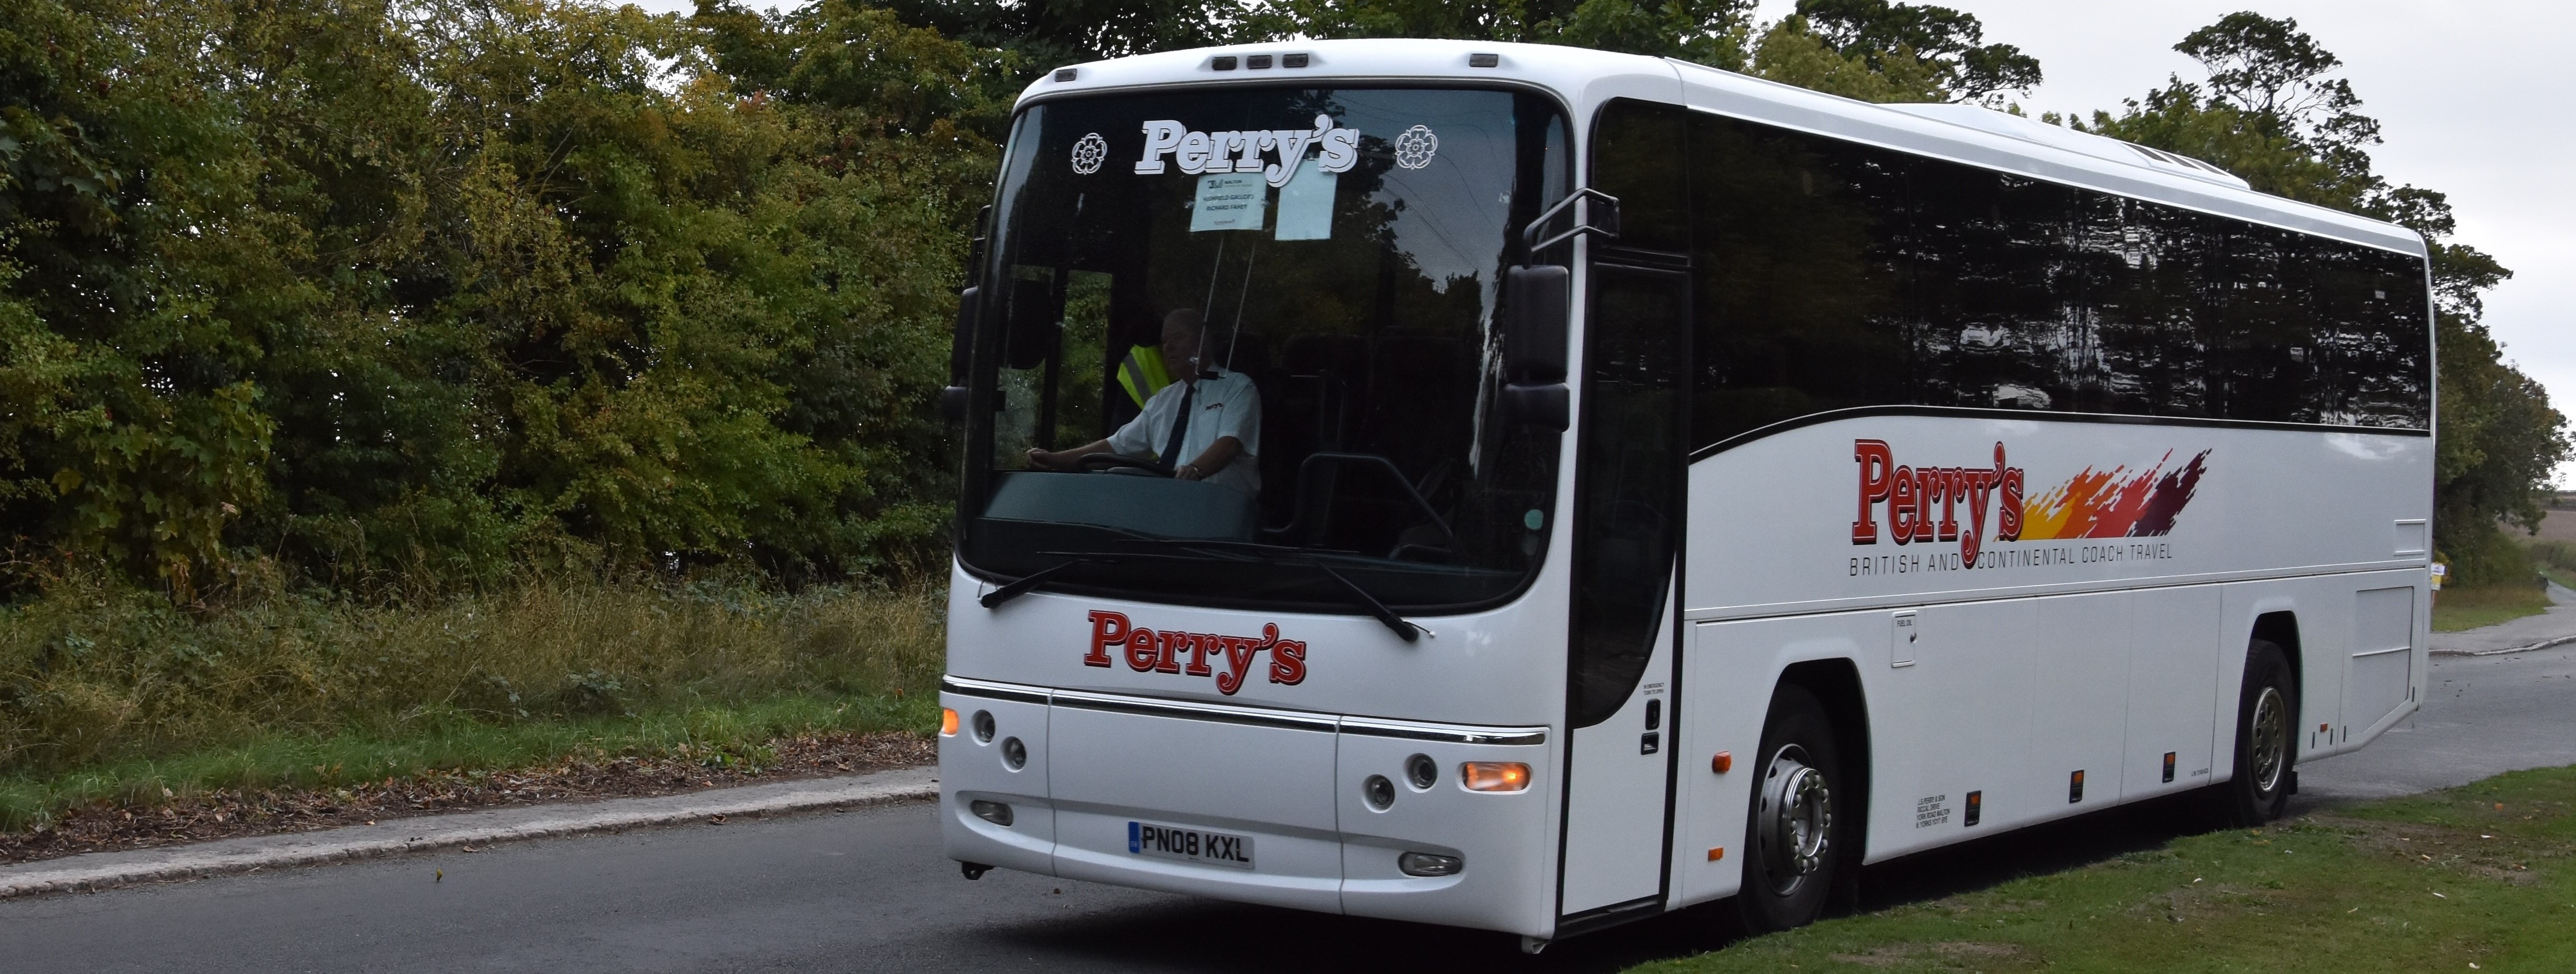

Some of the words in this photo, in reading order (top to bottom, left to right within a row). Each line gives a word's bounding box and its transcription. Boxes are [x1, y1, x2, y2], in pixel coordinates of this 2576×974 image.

[1134, 114, 1359, 187] Perry's
[1852, 439, 2024, 569] Perry's
[1850, 555, 1919, 576] BRITISH
[1928, 553, 1958, 571] AND
[1977, 548, 2075, 569] CONTINENTAL
[2082, 545, 2123, 563] COACH
[2130, 543, 2172, 560] TRAVEL
[1084, 610, 1306, 695] Perry's
[1930, 803, 1940, 811] DRIVE
[1142, 826, 1199, 856] PN08
[1206, 834, 1249, 862] KXL
